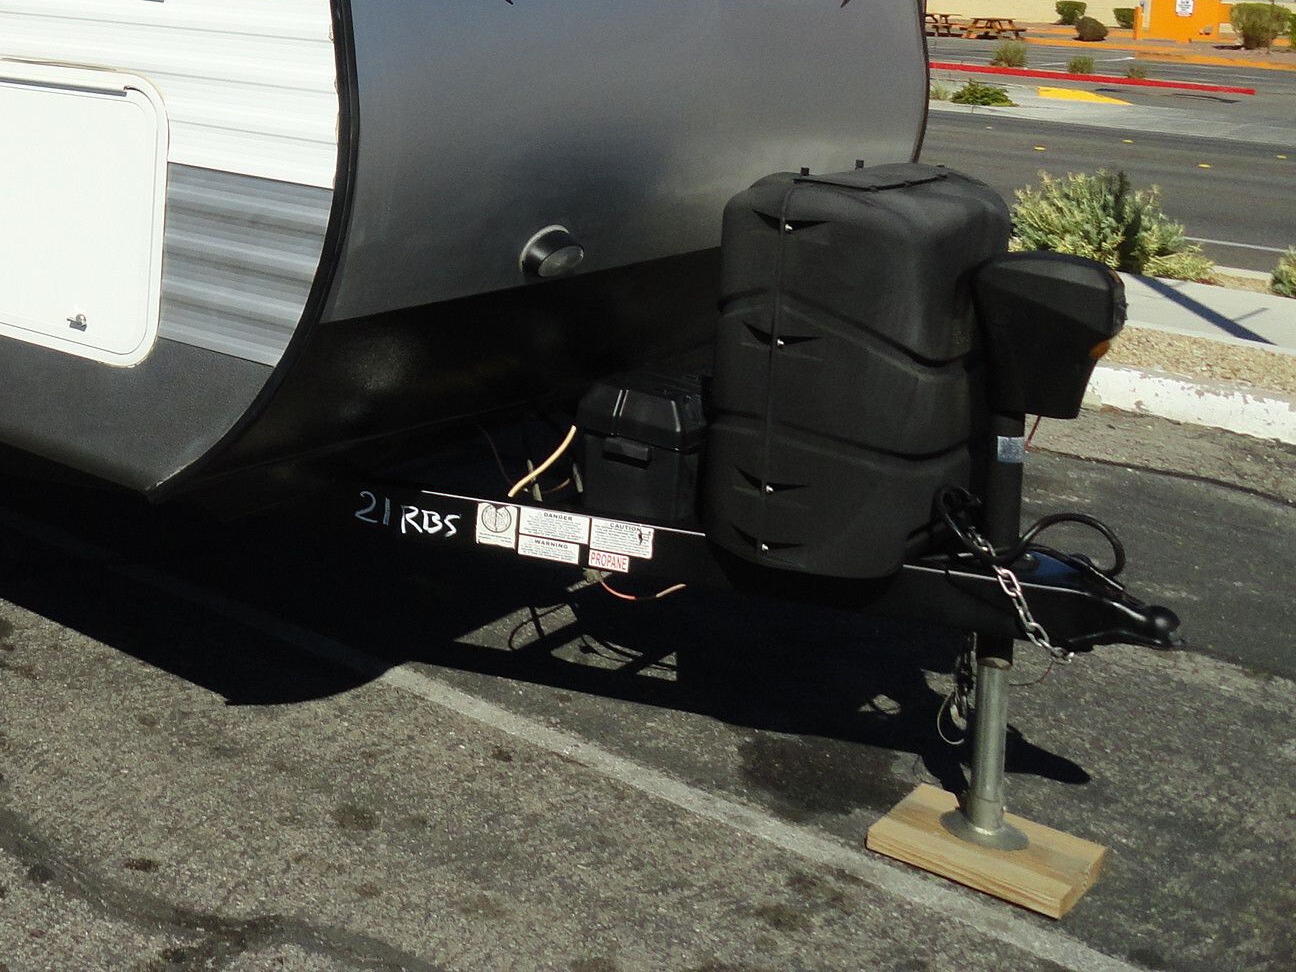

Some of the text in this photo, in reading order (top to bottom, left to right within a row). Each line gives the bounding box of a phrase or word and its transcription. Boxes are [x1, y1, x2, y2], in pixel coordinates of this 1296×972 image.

[354, 490, 462, 538] 21 RBS
[543, 512, 573, 521] DANGER
[609, 522, 642, 532] CAUTION
[534, 539, 569, 549] WARNING
[590, 552, 628, 571] PROPANE
